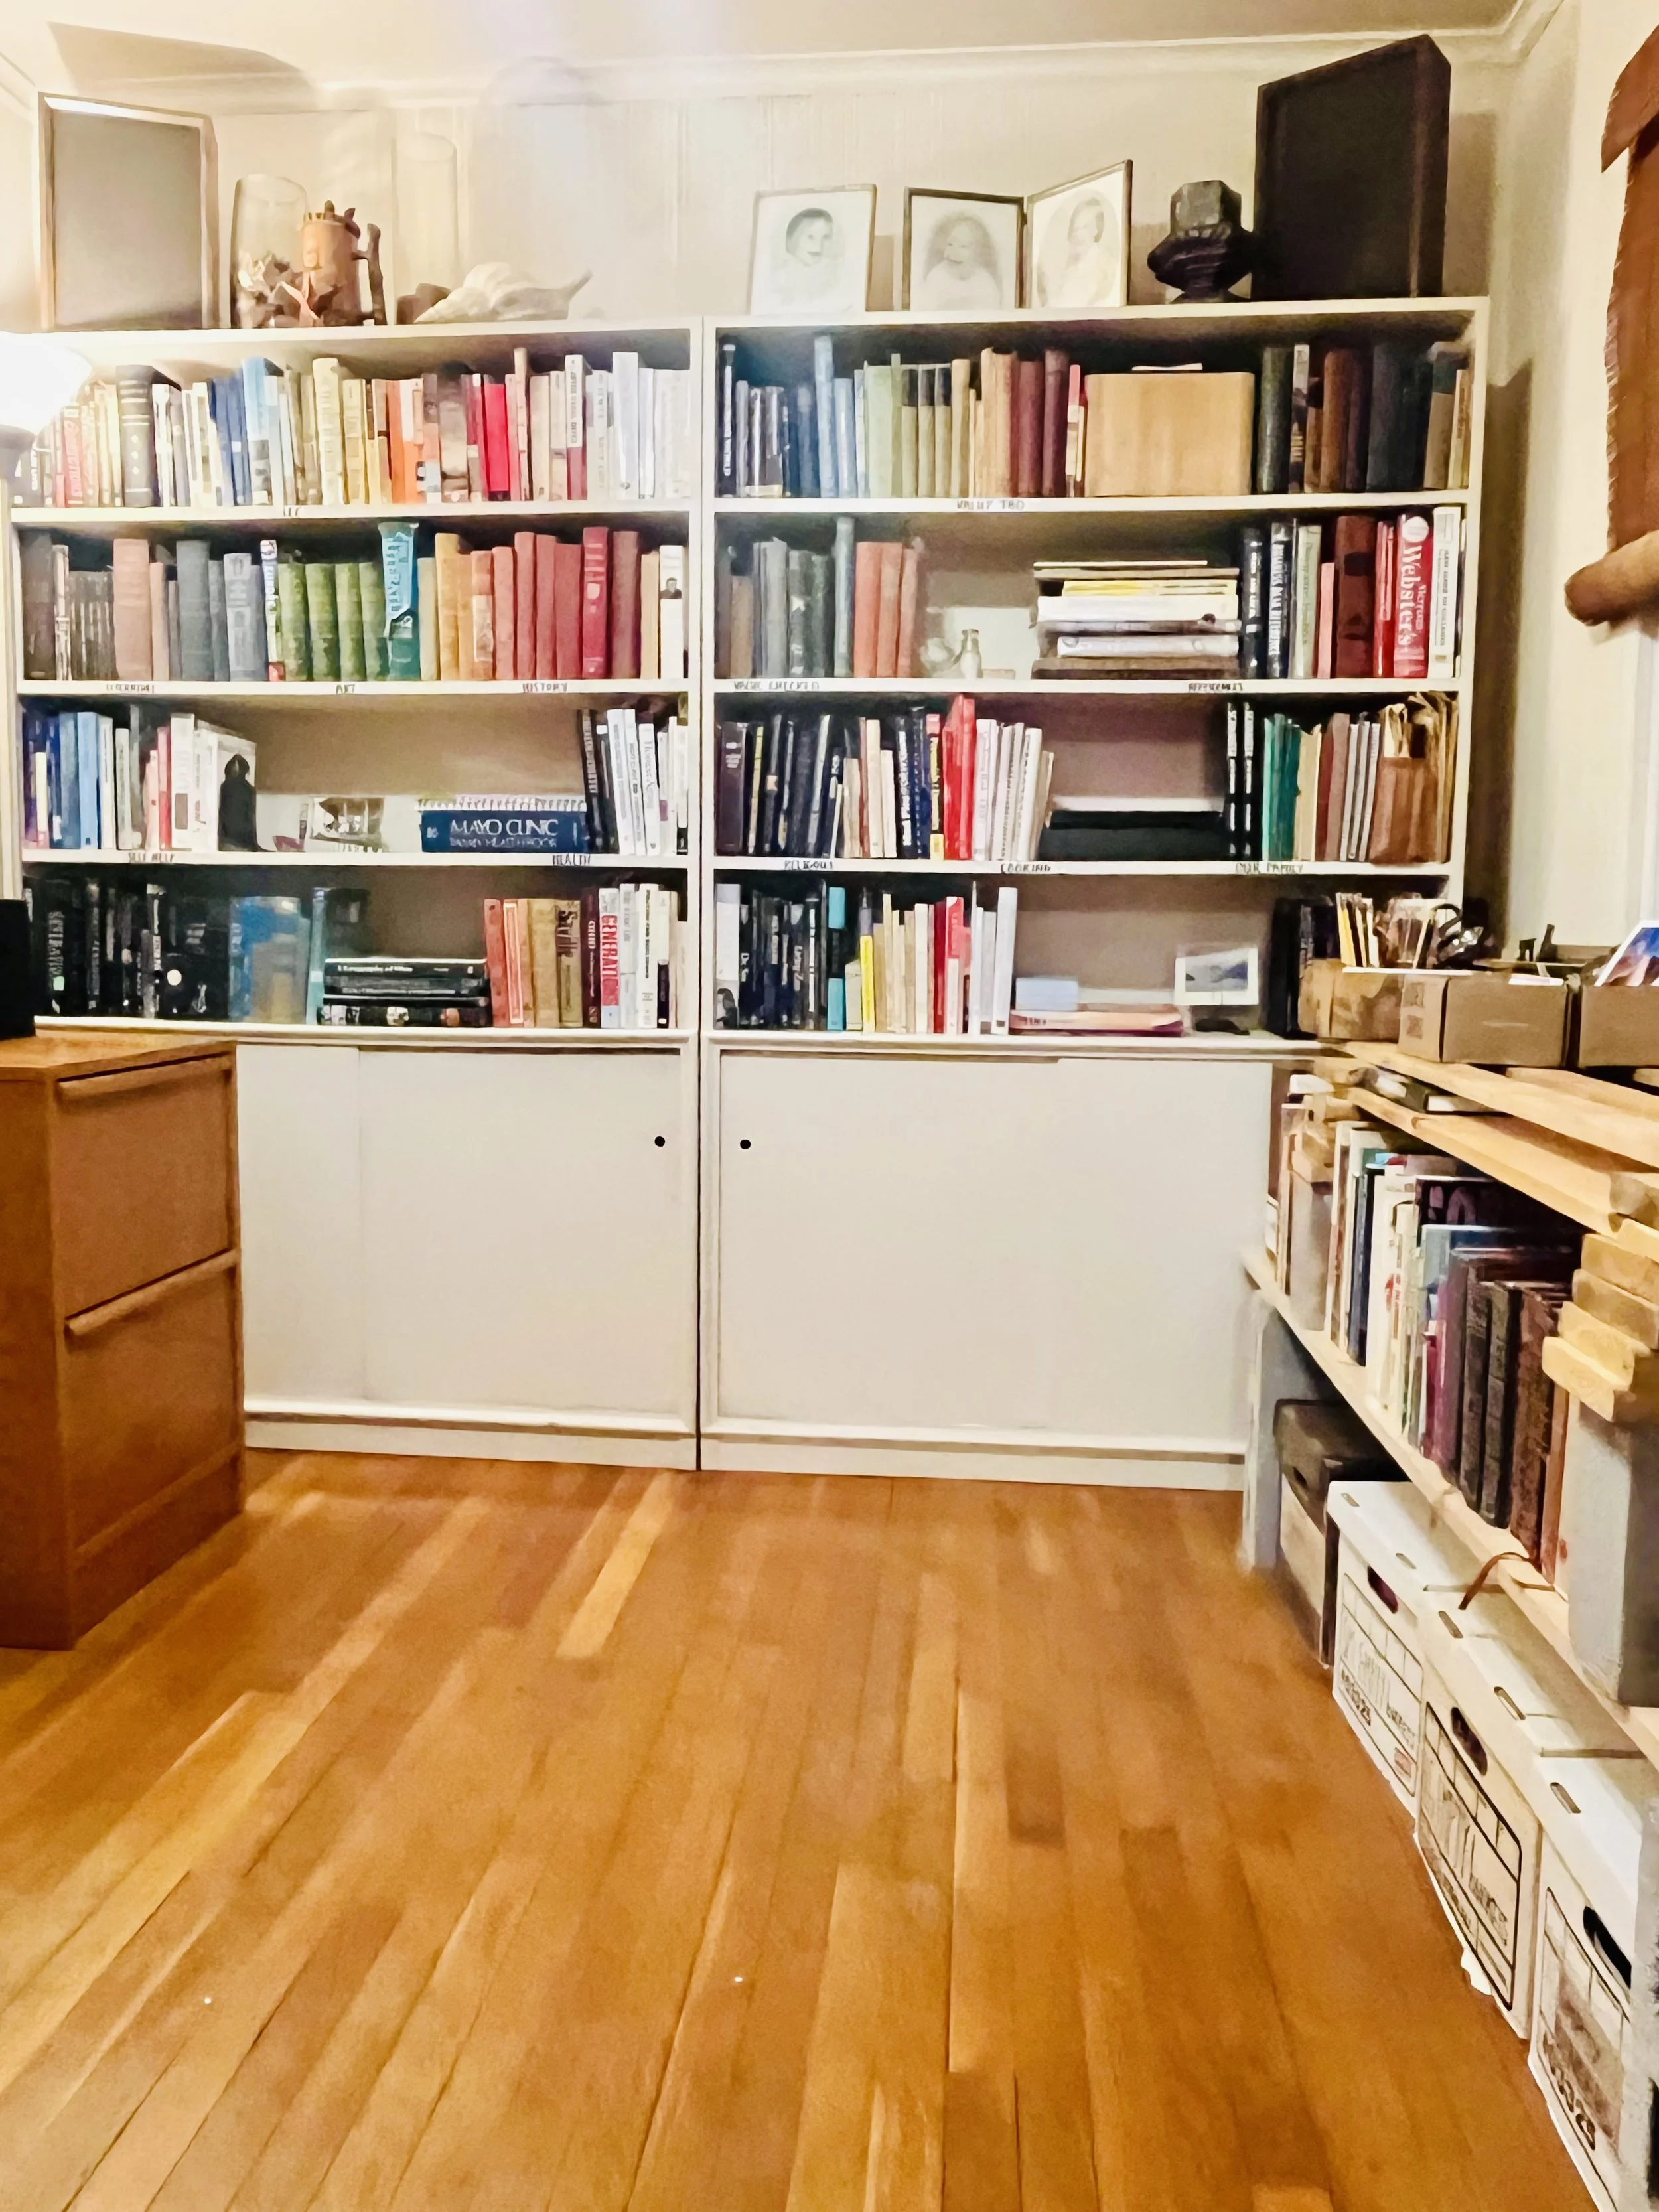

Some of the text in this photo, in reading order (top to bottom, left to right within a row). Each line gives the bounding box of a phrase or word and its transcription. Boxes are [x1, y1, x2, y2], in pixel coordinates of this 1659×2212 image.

[1398, 545, 1422, 646] Webster's
[336, 684, 356, 694] ART
[522, 683, 568, 693] HISTORY
[450, 820, 559, 836] MAYO CLINIC
[601, 915, 618, 1005] GENERATI
